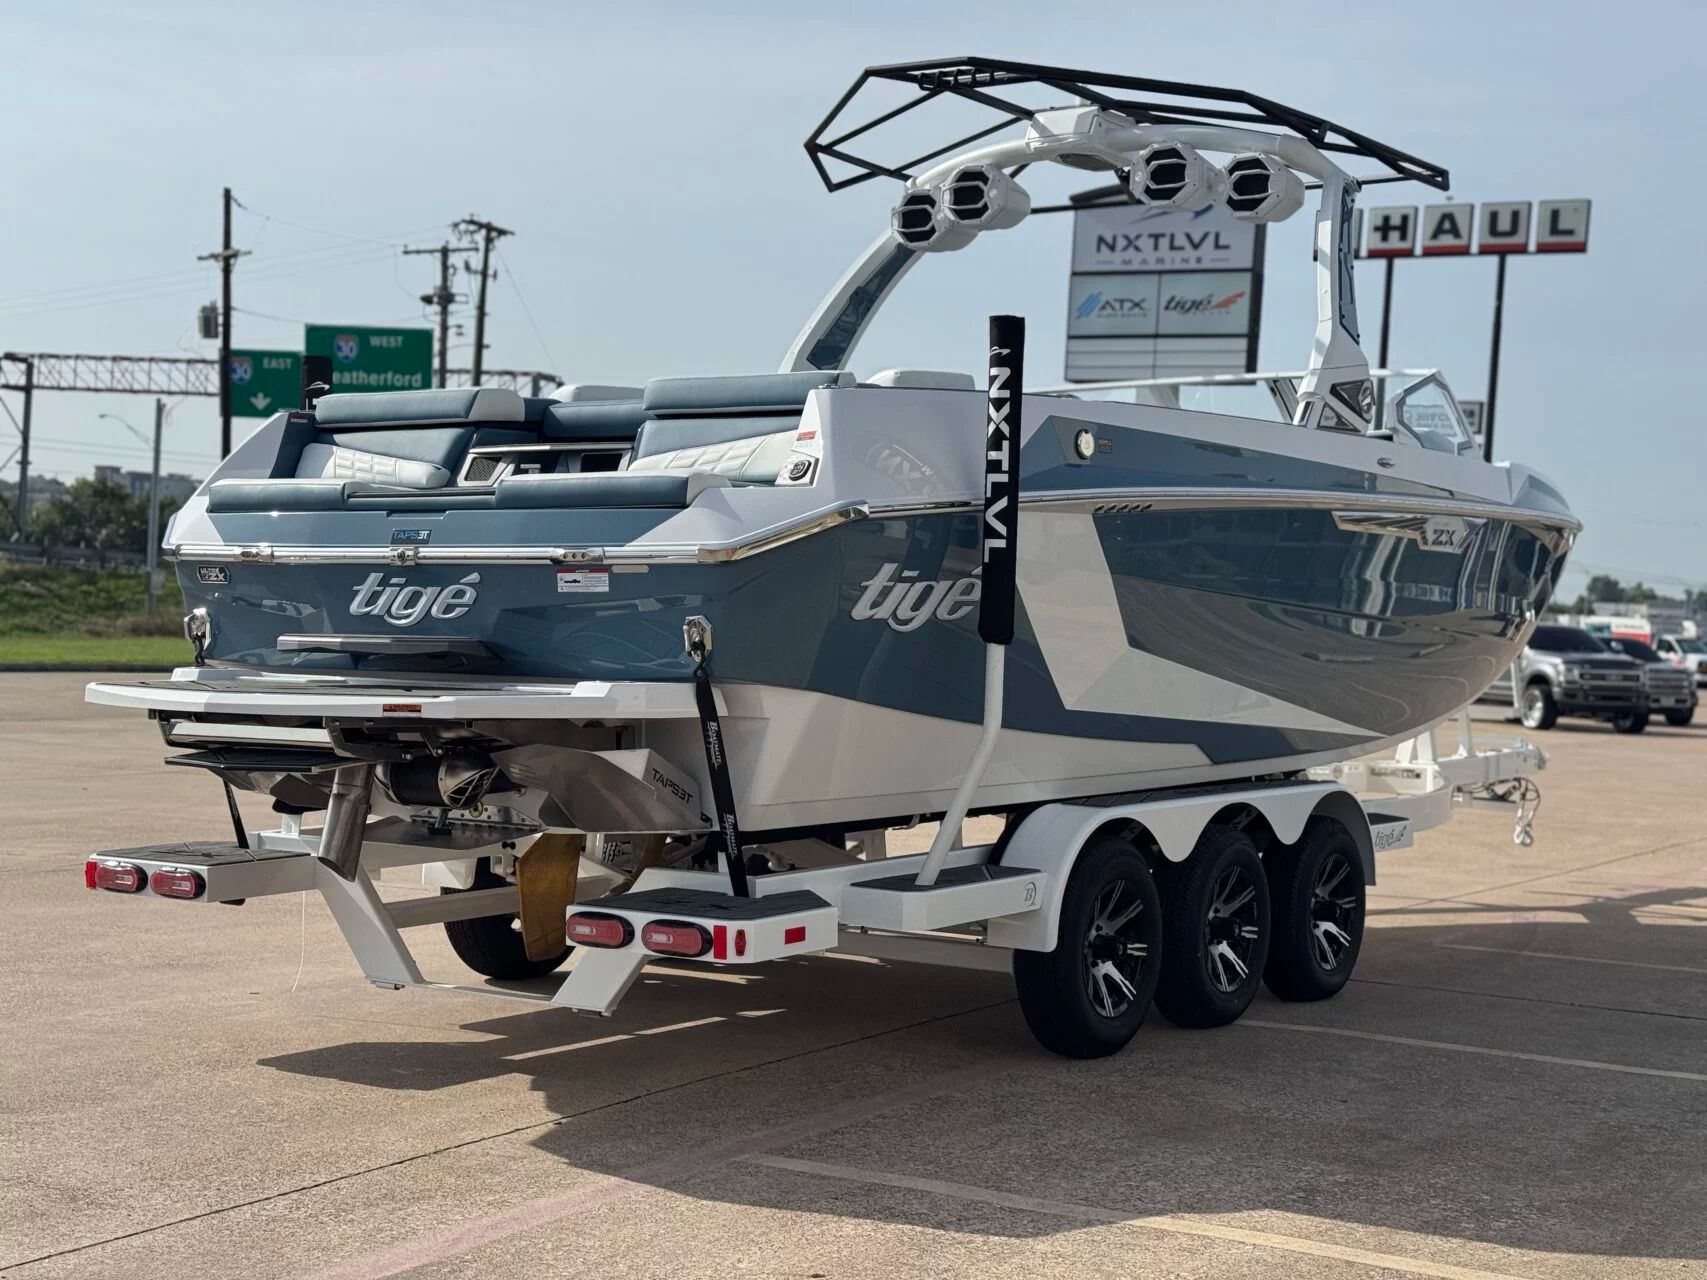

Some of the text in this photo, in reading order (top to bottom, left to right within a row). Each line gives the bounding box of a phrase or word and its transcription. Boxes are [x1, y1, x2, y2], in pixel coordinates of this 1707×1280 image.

[1096, 231, 1231, 253] NXTLVL
[1121, 257, 1204, 266] MARINE
[1099, 298, 1147, 312] ATX
[369, 335, 404, 348] WEST
[262, 357, 293, 369] EAST
[332, 369, 423, 388] eatherford
[984, 366, 1011, 563] NXTLVL
[1431, 528, 1457, 547] ZX
[350, 572, 481, 627] tigé
[850, 562, 982, 632] tigé
[652, 767, 694, 805] TAPS3T
